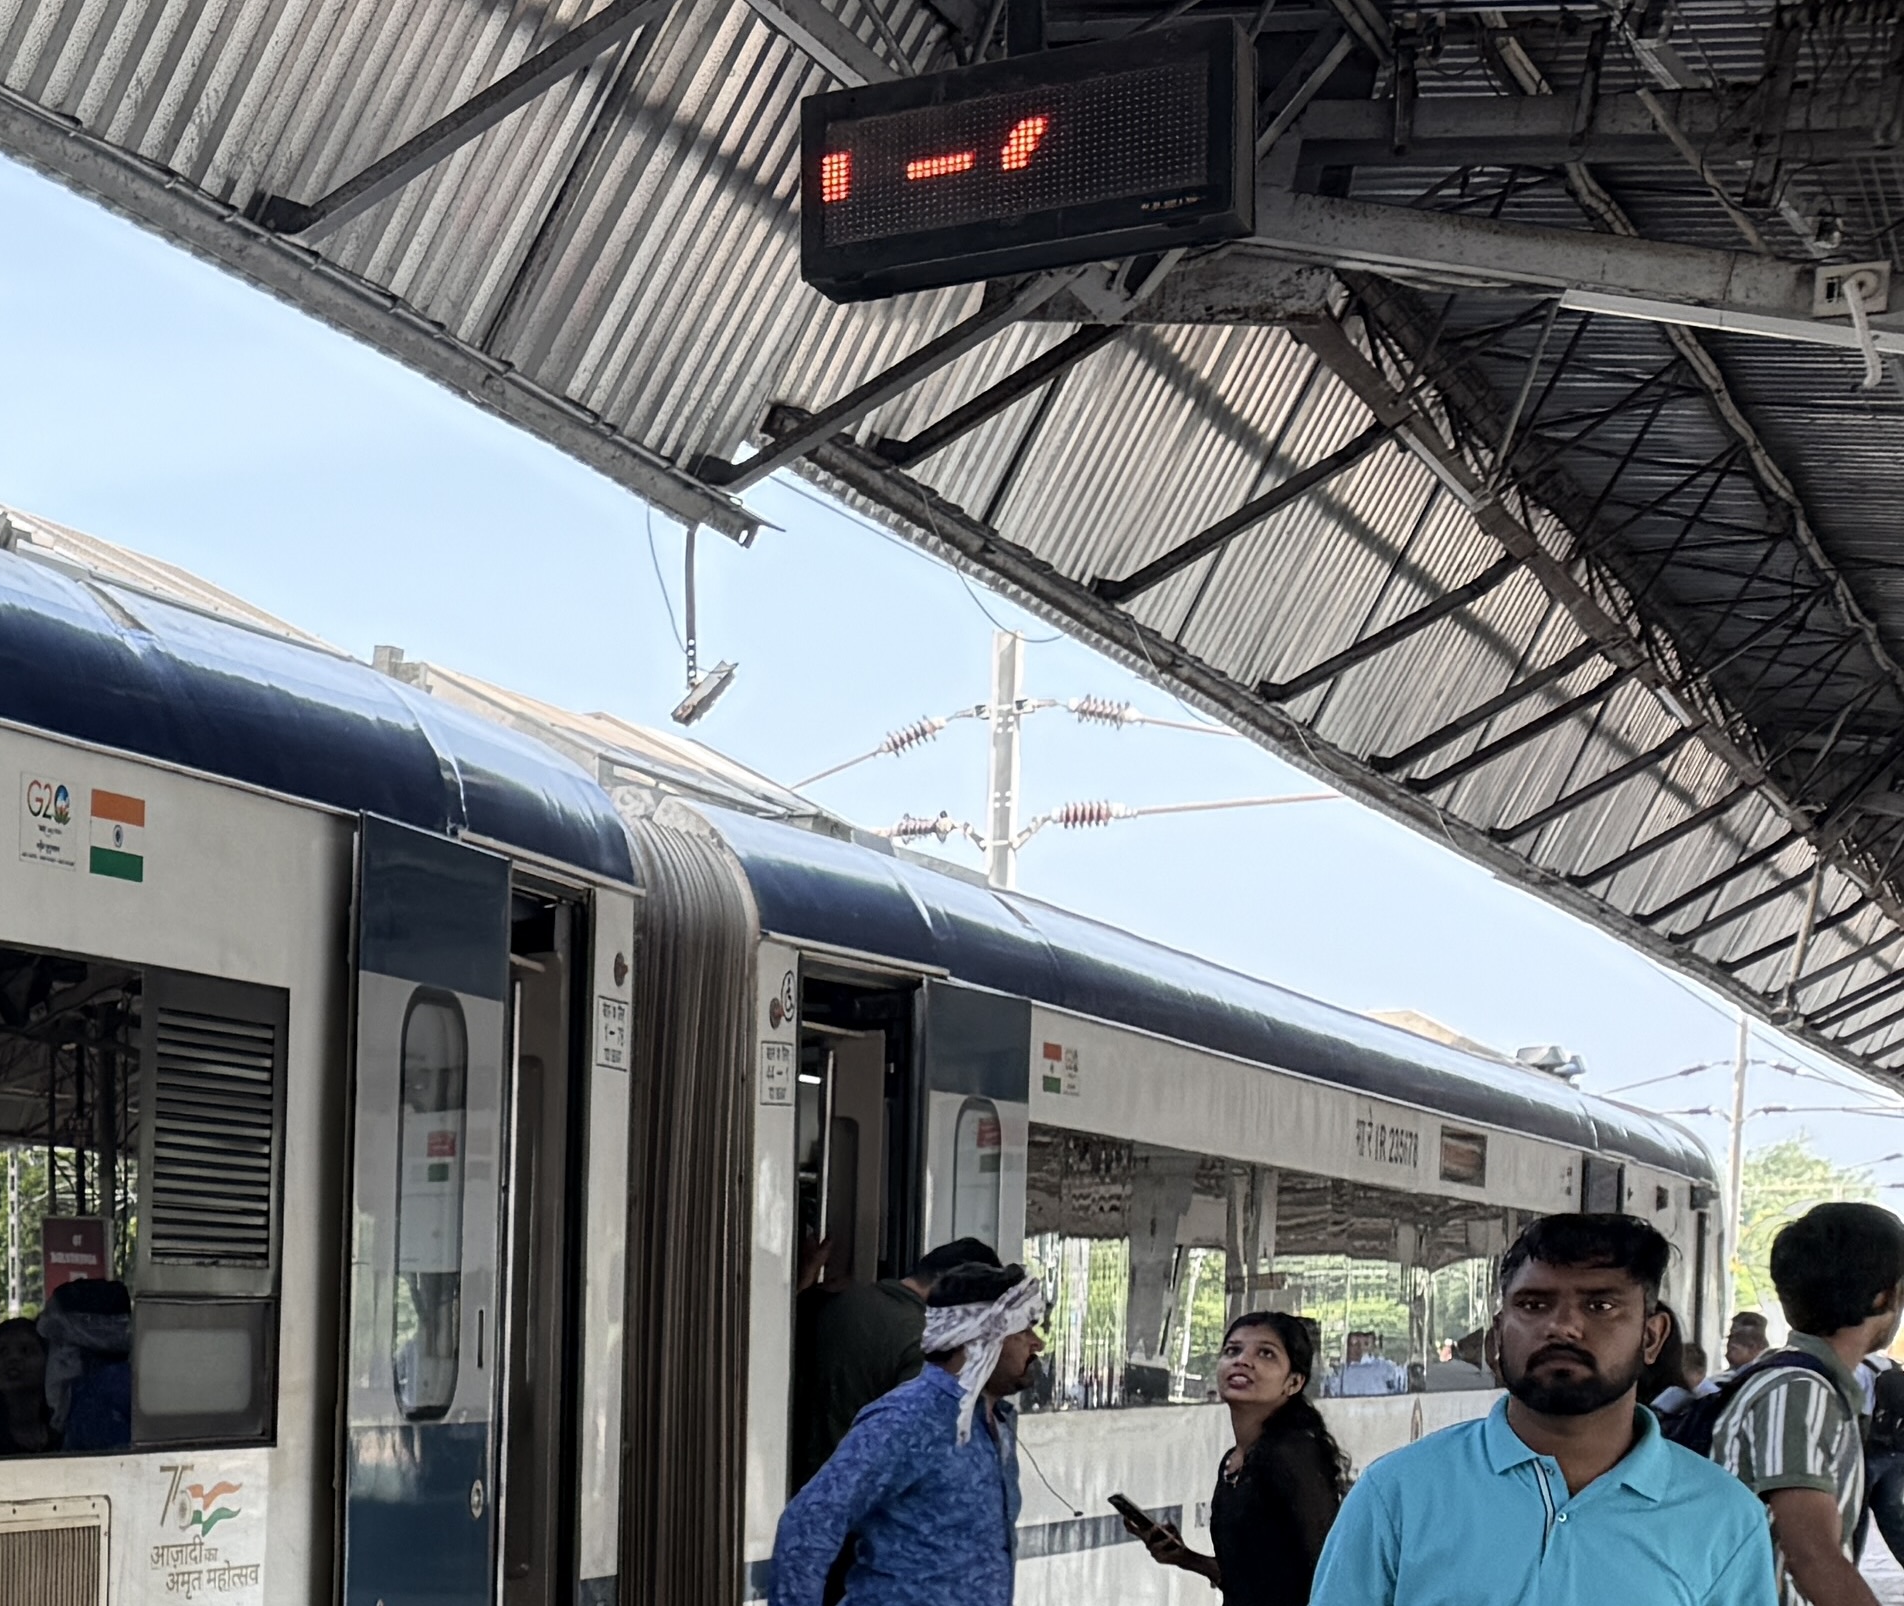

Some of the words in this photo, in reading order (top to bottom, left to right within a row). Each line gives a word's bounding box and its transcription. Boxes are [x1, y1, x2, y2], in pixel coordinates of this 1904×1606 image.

[26, 779, 71, 826] G20
[166, 1568, 202, 1600] अमृत
[206, 1560, 261, 1593] महोत्सव
